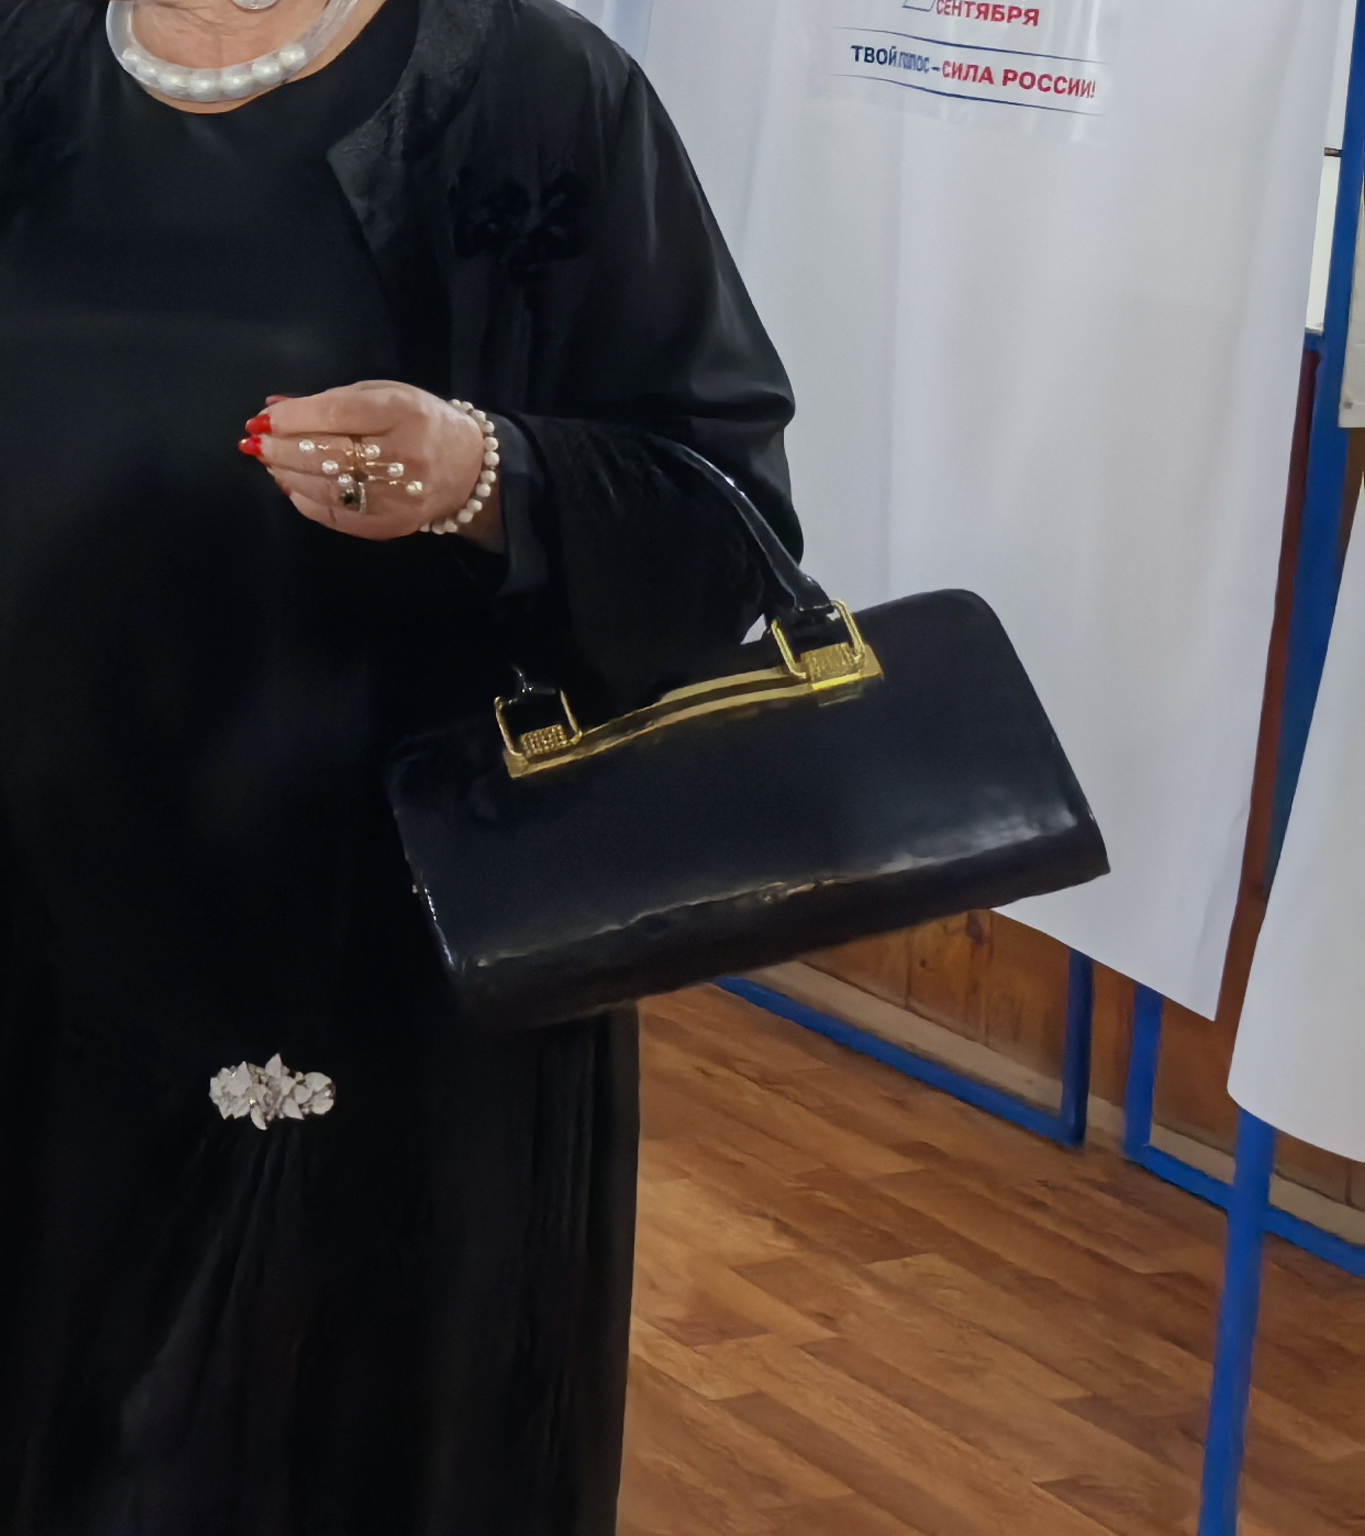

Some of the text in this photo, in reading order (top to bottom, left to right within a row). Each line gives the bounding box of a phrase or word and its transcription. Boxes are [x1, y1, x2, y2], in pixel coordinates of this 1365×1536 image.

[850, 44, 897, 66] ТВОЙ
[941, 60, 994, 86] СИЛА
[1002, 68, 1096, 99] РОССИИ!
